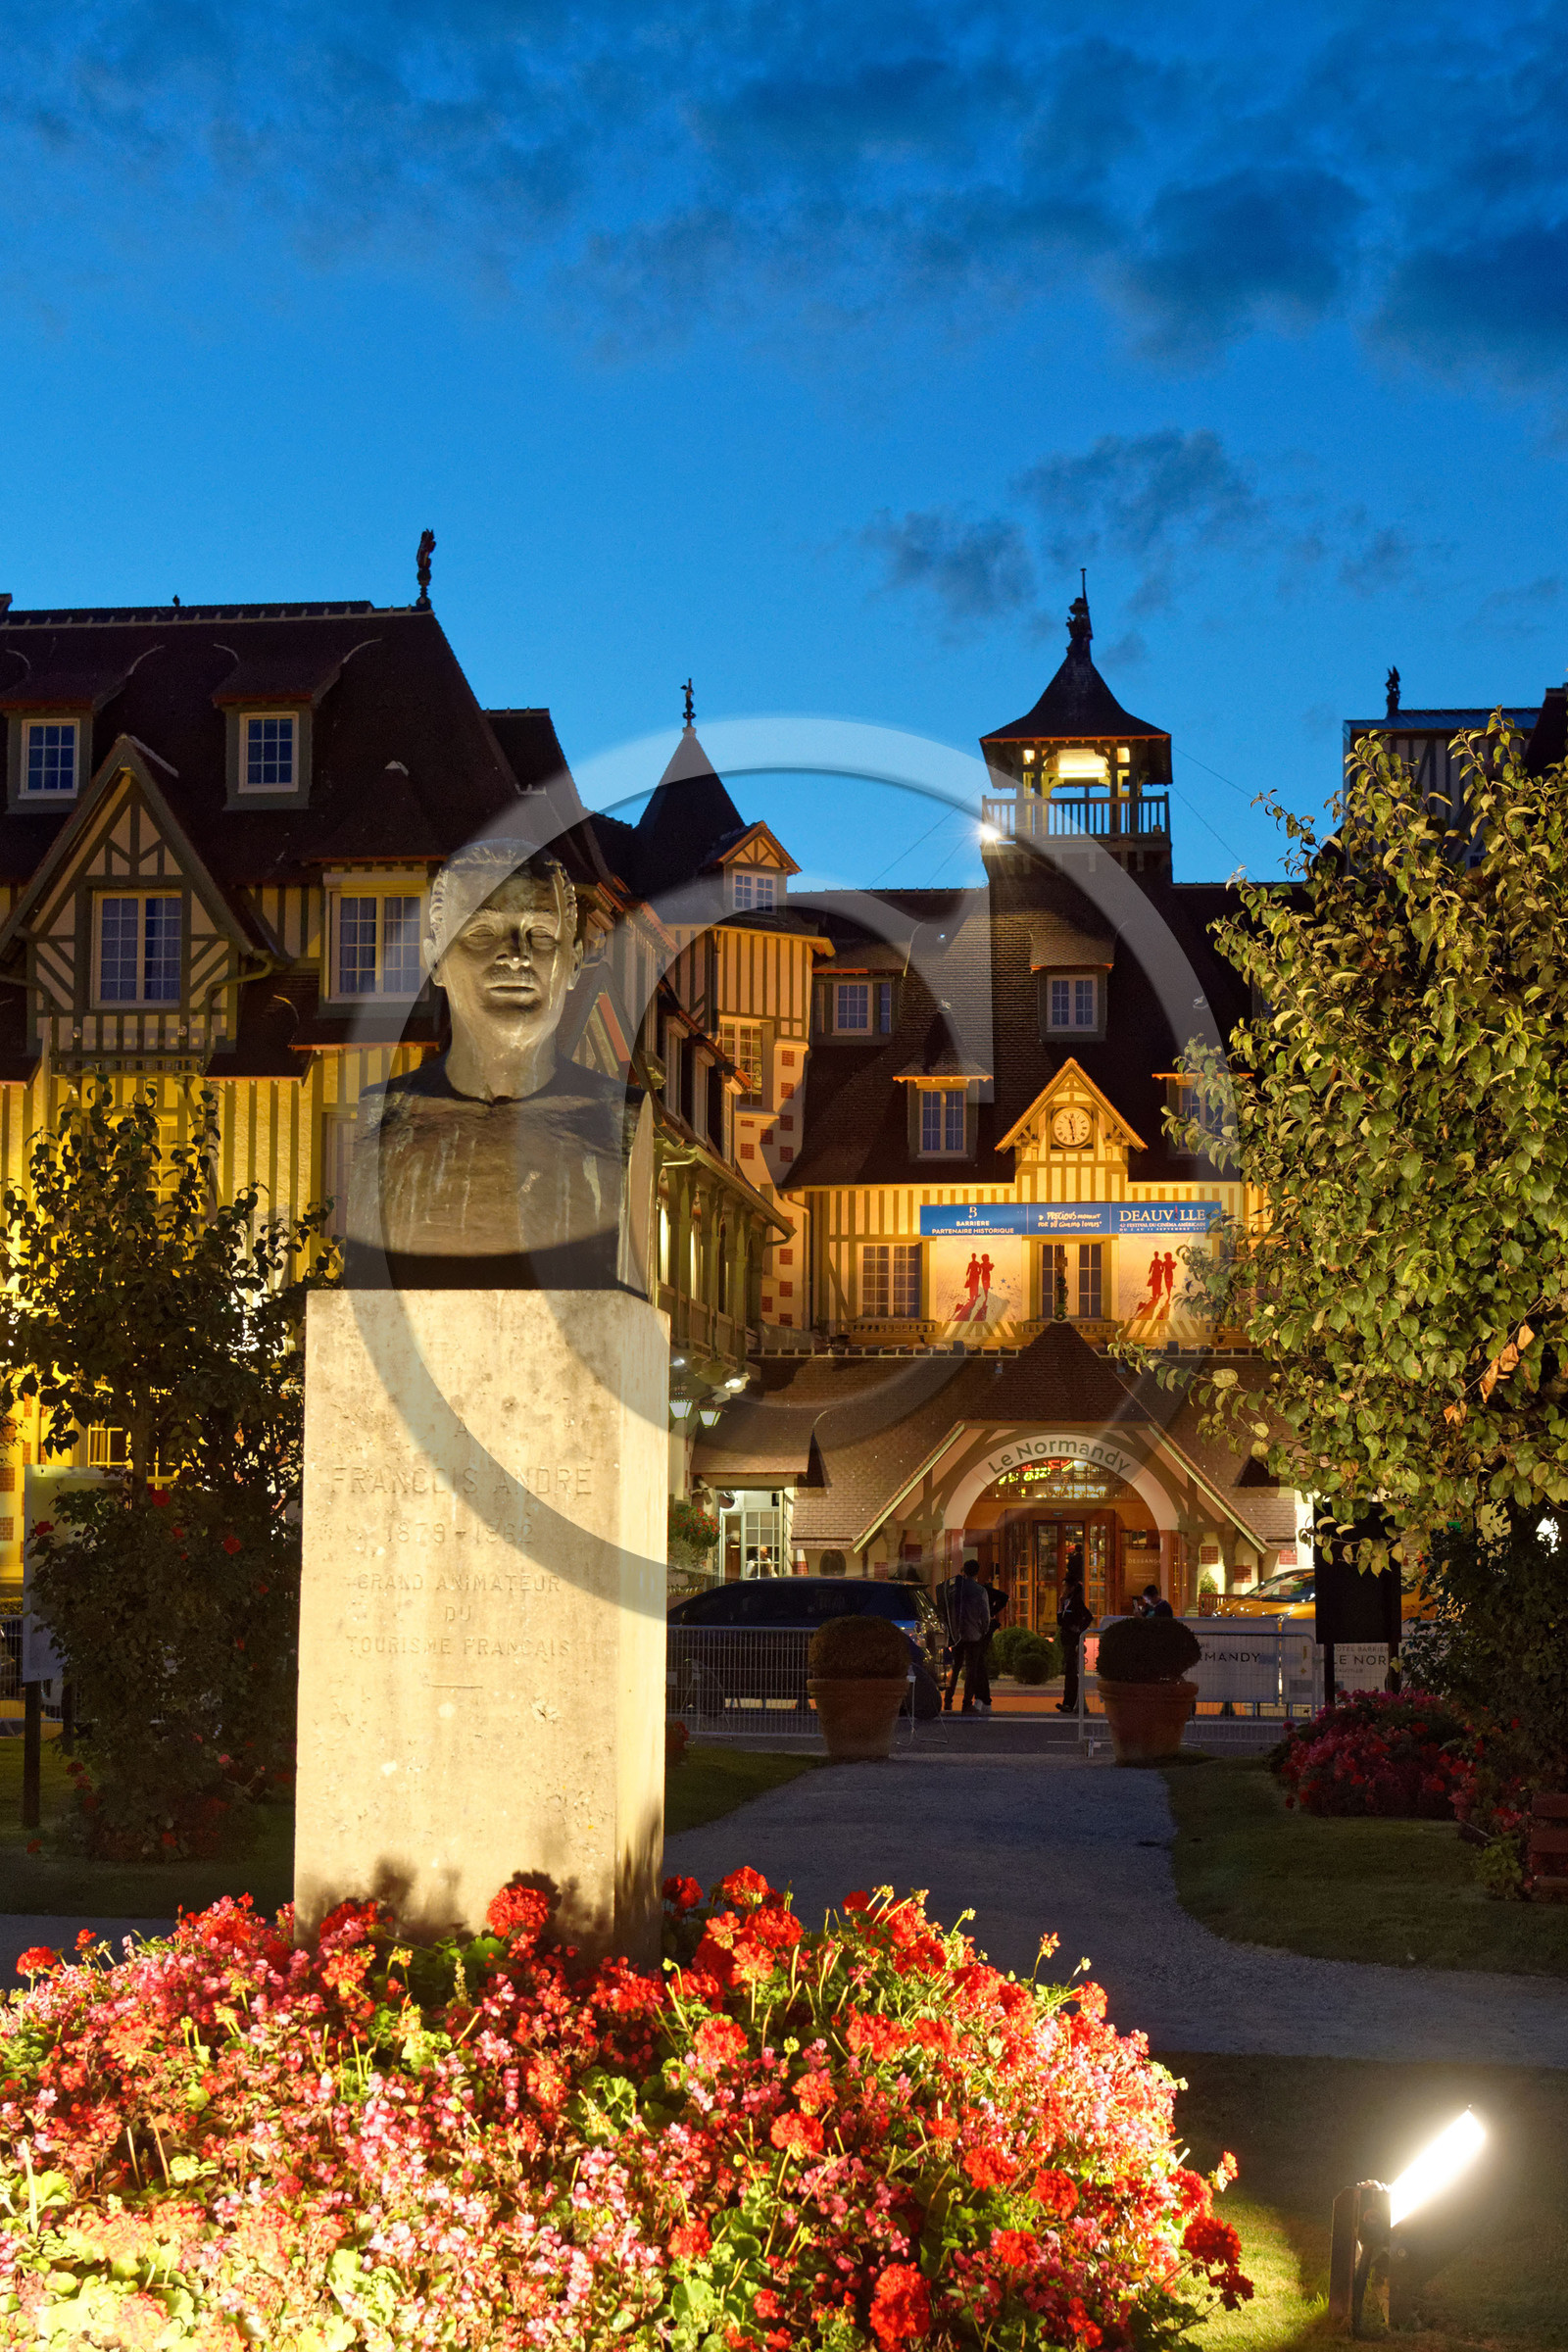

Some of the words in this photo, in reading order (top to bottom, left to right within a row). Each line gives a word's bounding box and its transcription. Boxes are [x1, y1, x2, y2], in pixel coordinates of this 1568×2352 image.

[988, 1454, 1013, 1474] Le
[1015, 1440, 1131, 1474] Normandy
[357, 1573, 424, 1591] GRAND
[436, 1574, 561, 1592] ANIMATEUR
[445, 1605, 472, 1623] DU
[346, 1635, 452, 1655] TOURISME
[1200, 1652, 1260, 1663] MANDY
[1353, 1654, 1387, 1666] NOR
